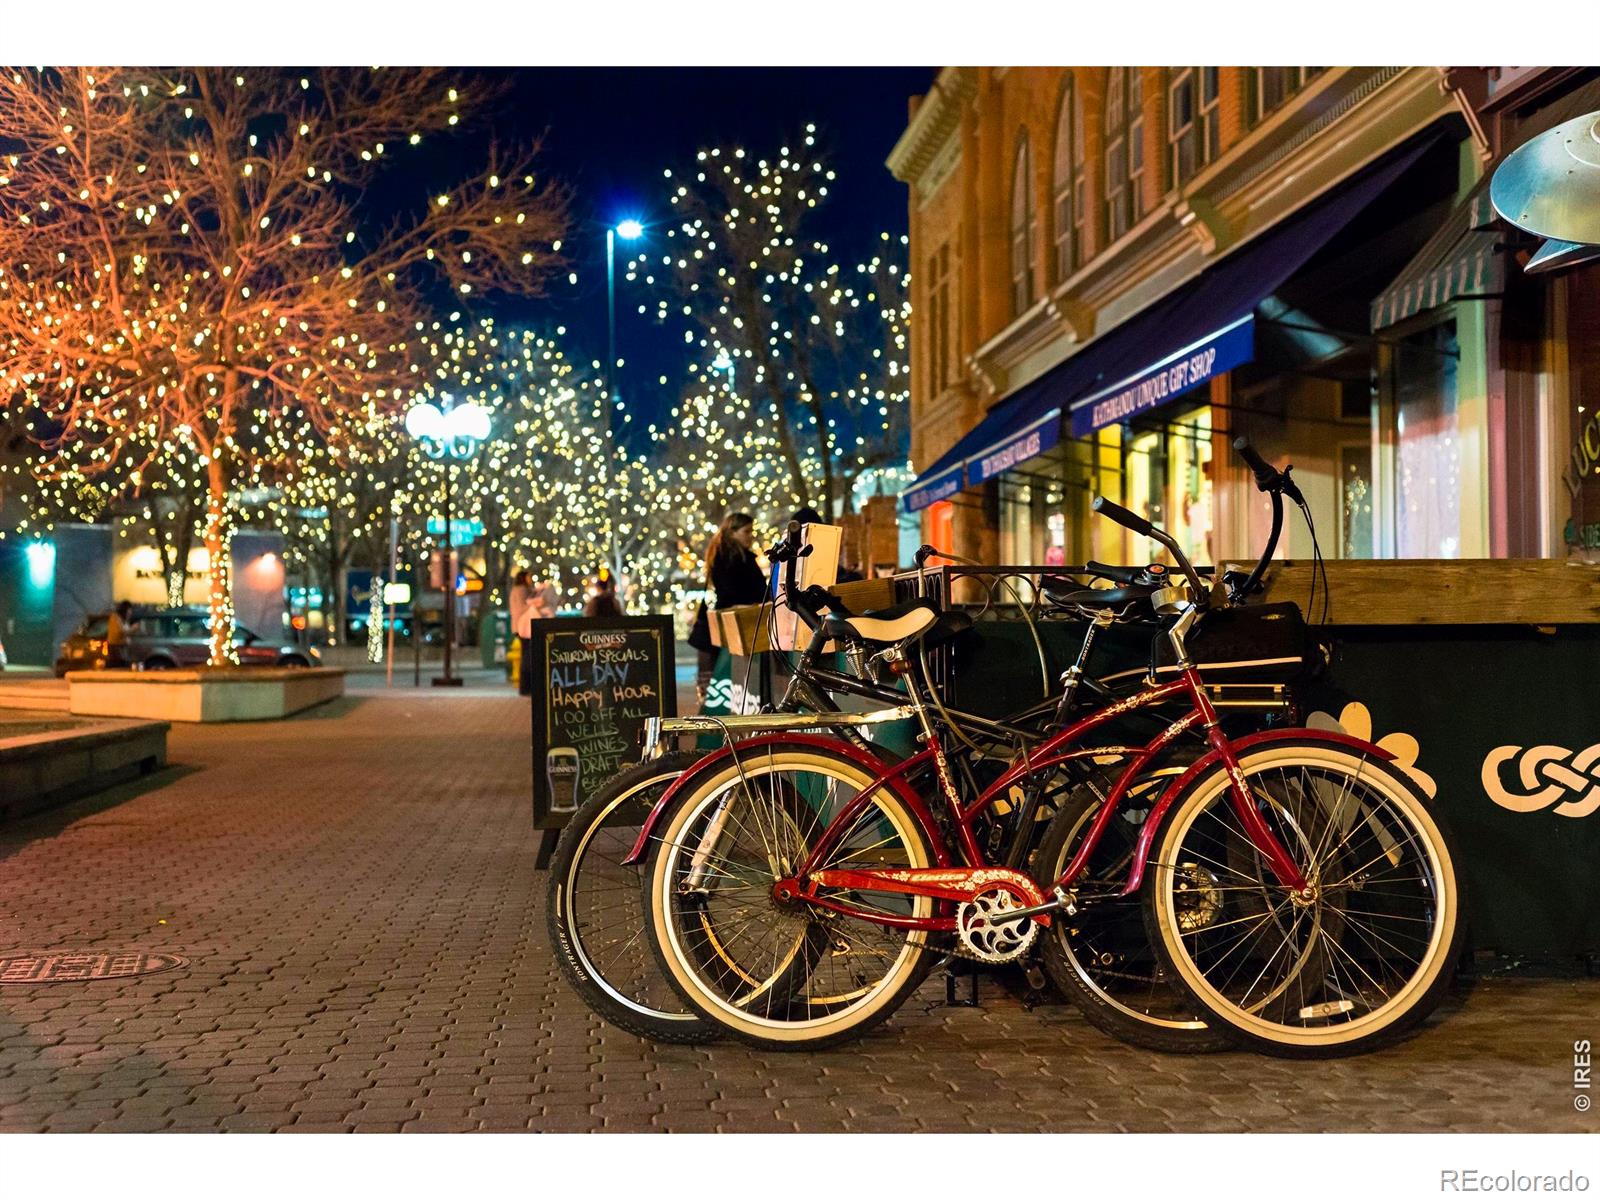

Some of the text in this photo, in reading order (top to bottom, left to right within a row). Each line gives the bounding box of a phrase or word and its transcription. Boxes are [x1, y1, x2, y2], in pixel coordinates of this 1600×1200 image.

[1137, 371, 1168, 407] UNIQUE
[1169, 361, 1190, 393] GIFT
[1189, 347, 1216, 383] SHOP
[579, 632, 628, 644] GUINNESS
[551, 662, 629, 688] ALL DAY
[552, 684, 656, 708] HAPPY HOUR
[622, 707, 650, 719] ALL
[566, 722, 619, 739] WELLS
[579, 736, 629, 754] WINES
[581, 754, 622, 775] DRAFT
[559, 931, 588, 981] BONTRAGER
